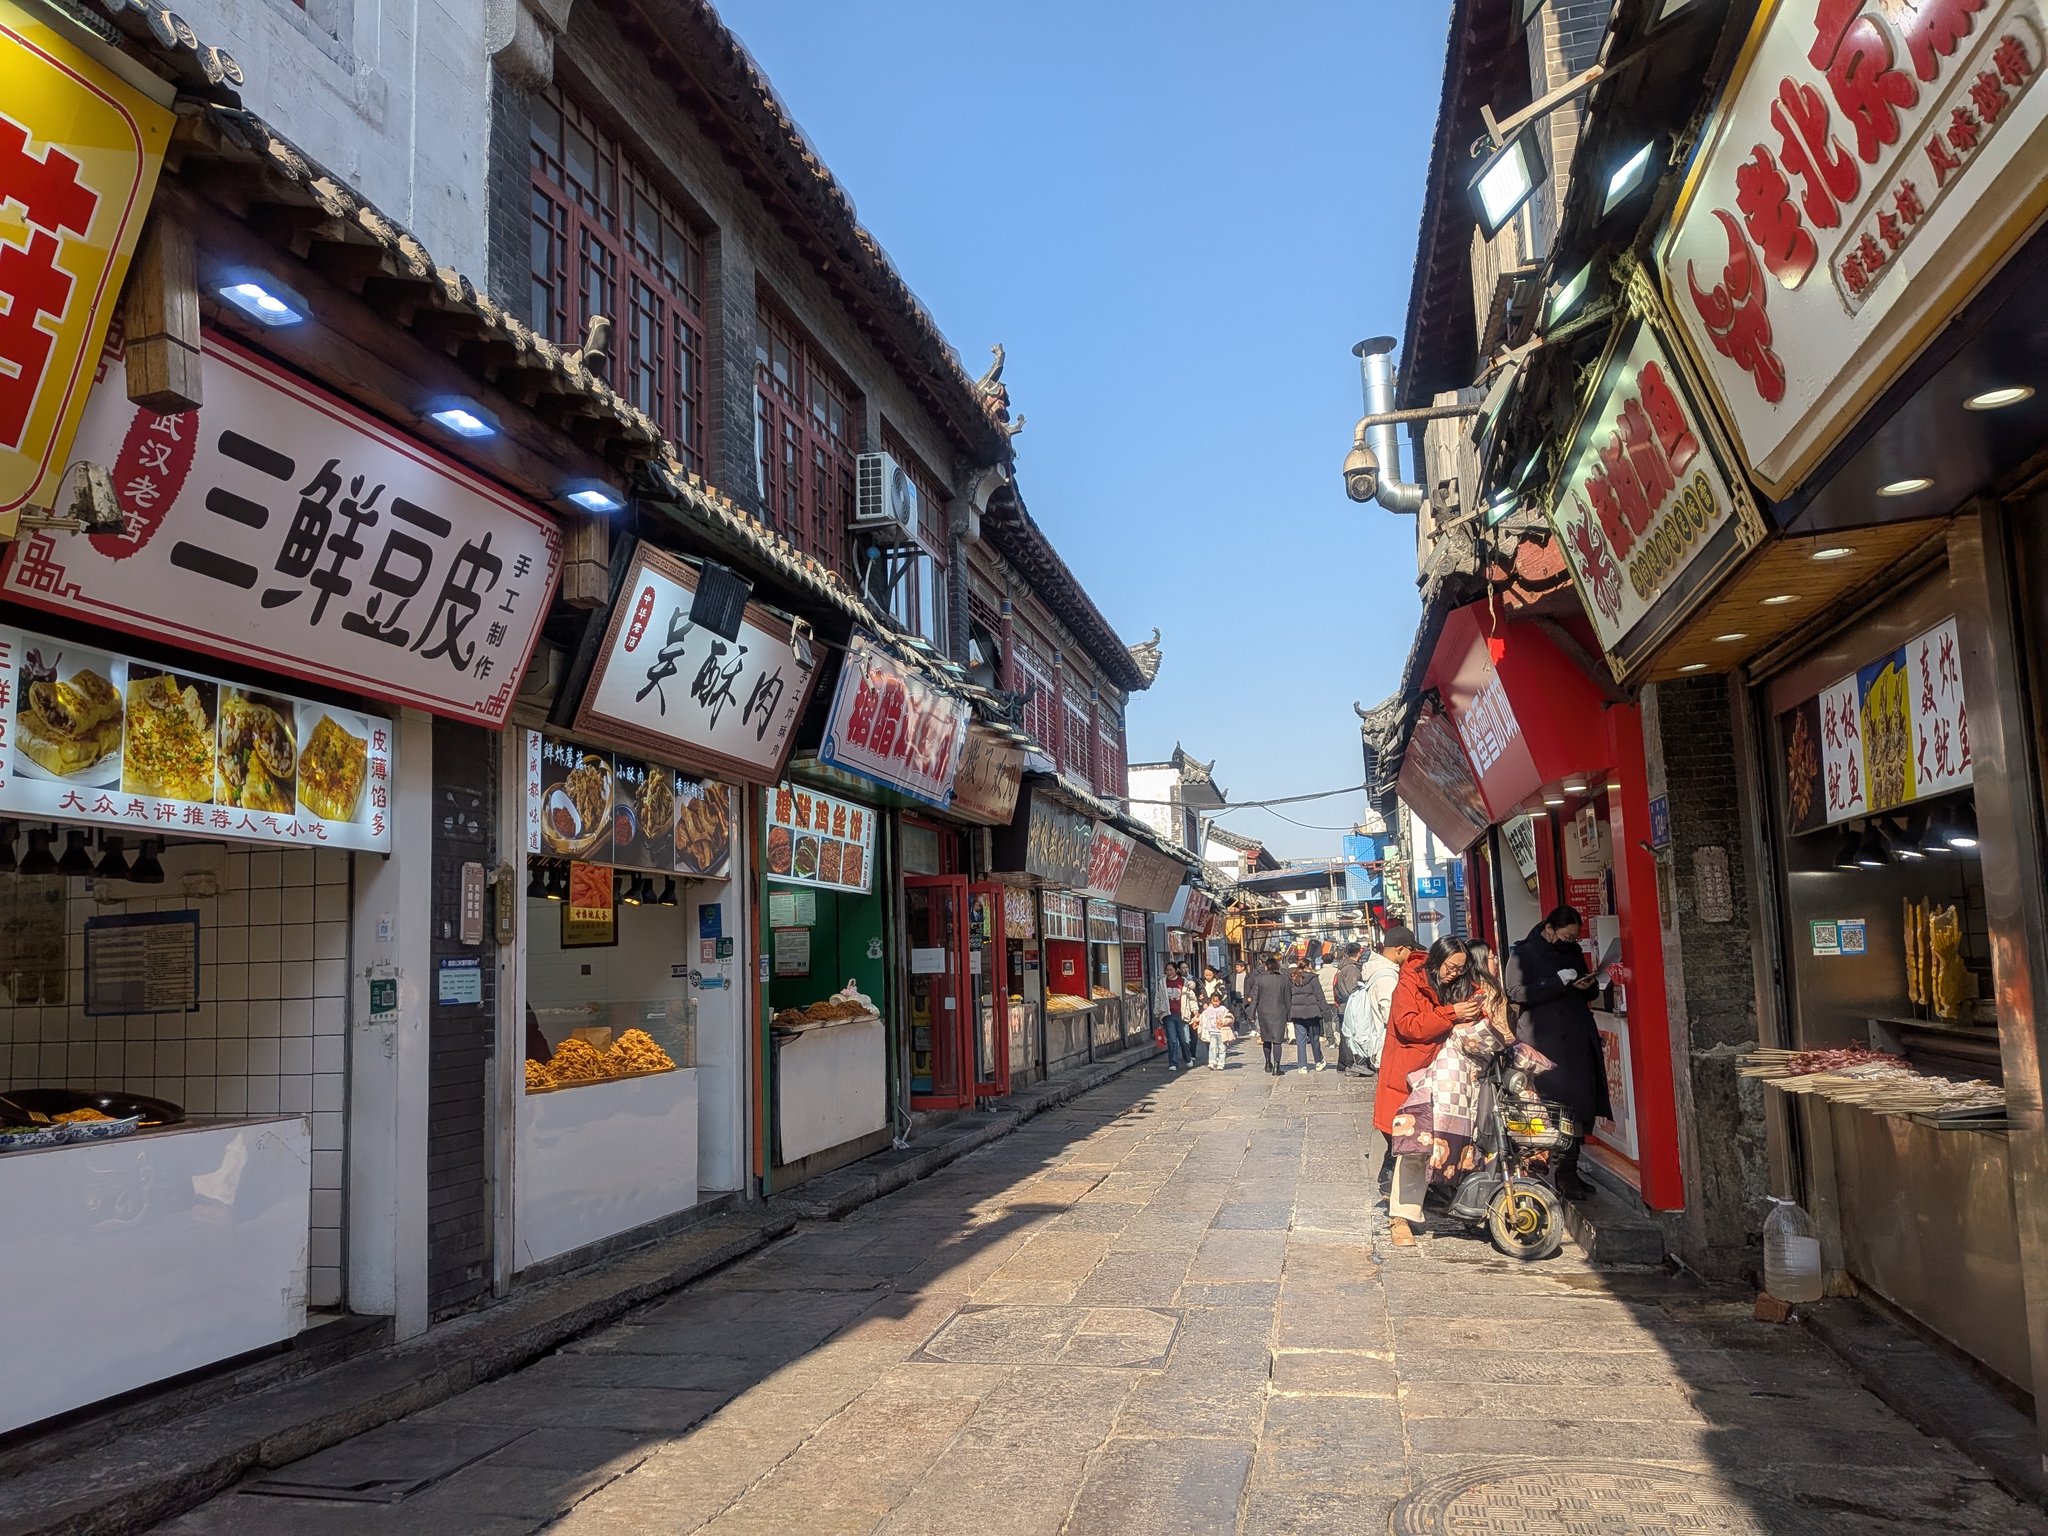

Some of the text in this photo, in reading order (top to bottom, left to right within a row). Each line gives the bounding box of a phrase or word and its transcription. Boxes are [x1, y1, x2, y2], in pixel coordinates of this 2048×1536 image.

[1841, 178, 1925, 294] 精选食材
[120, 408, 188, 545] 武汉老店
[170, 430, 504, 672] 三鲜豆皮
[471, 553, 534, 681] 手工制作
[626, 593, 652, 648] 中华老店
[635, 606, 784, 742] 吴酥肉
[1919, 632, 1958, 715] 轰炸
[542, 741, 587, 771] 鲜炸蘑菇
[1823, 692, 1859, 750] 铁板
[1916, 702, 1972, 785] 大鱿鱼
[58, 790, 329, 841] 大众点评推荐人气小吃
[370, 728, 389, 837] 皮薄馅多
[528, 733, 540, 850] 老成都味道
[616, 764, 645, 785] 小酥肉
[775, 788, 863, 842] 糖醋鸡丝饼
[1828, 748, 1863, 810] 鱿鱼
[1422, 878, 1441, 888] 出口
